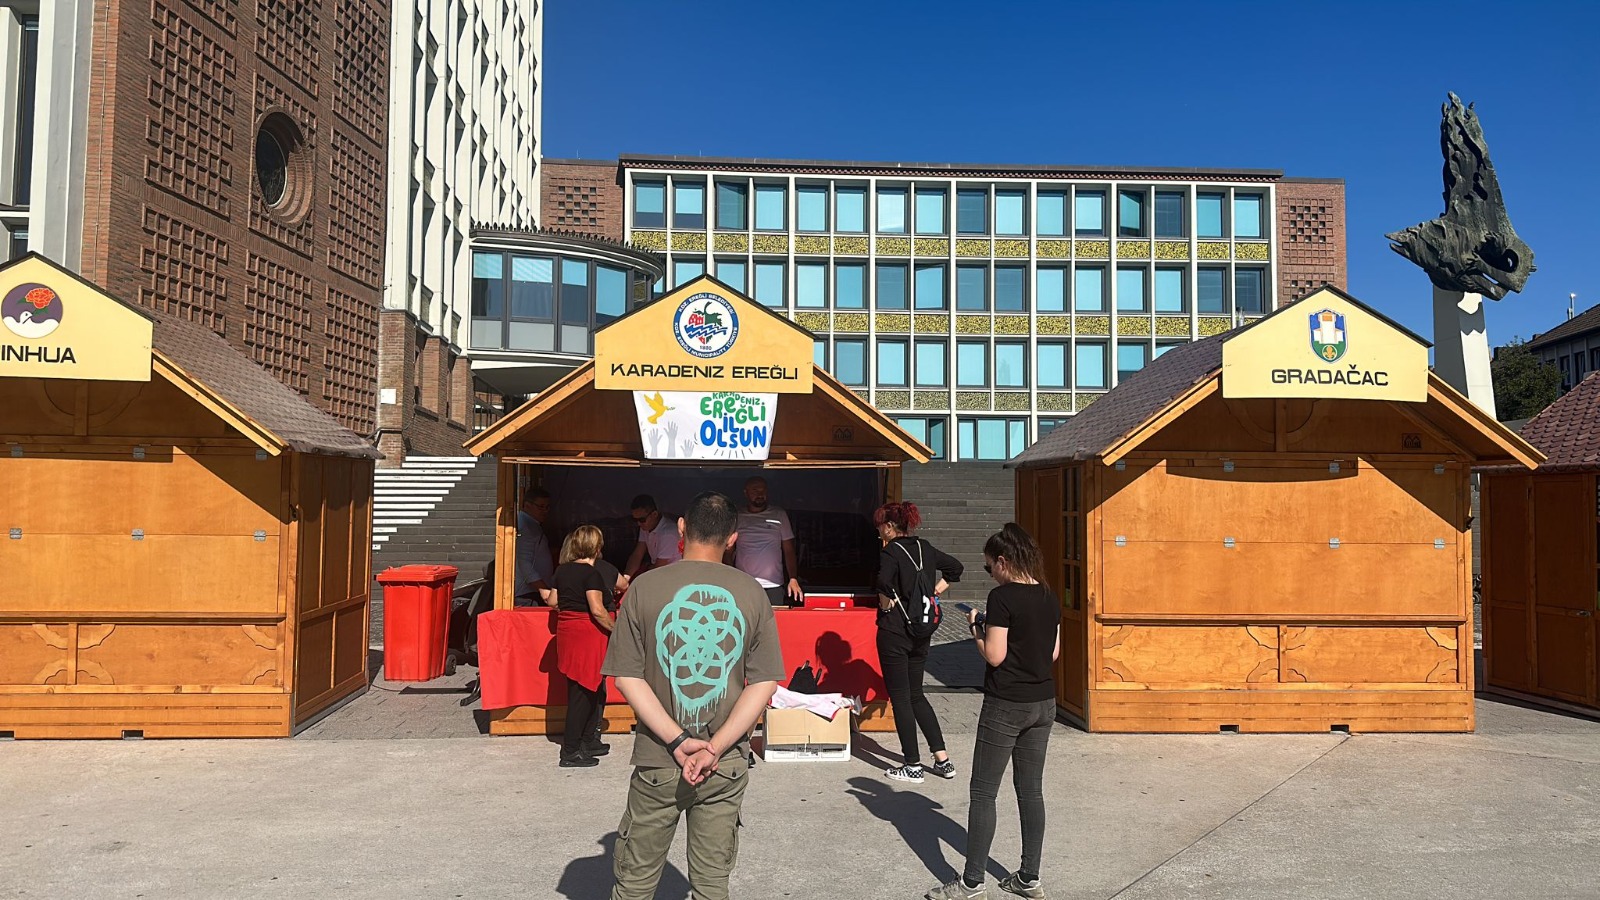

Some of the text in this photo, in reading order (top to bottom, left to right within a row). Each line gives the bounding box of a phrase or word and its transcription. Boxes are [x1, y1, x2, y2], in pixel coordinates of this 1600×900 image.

[0, 345, 76, 364] INHUA
[611, 364, 798, 380] KARADENIZ EREĞLI
[1271, 364, 1388, 386] GRADAČAC
[700, 420, 767, 448] OLSUN
